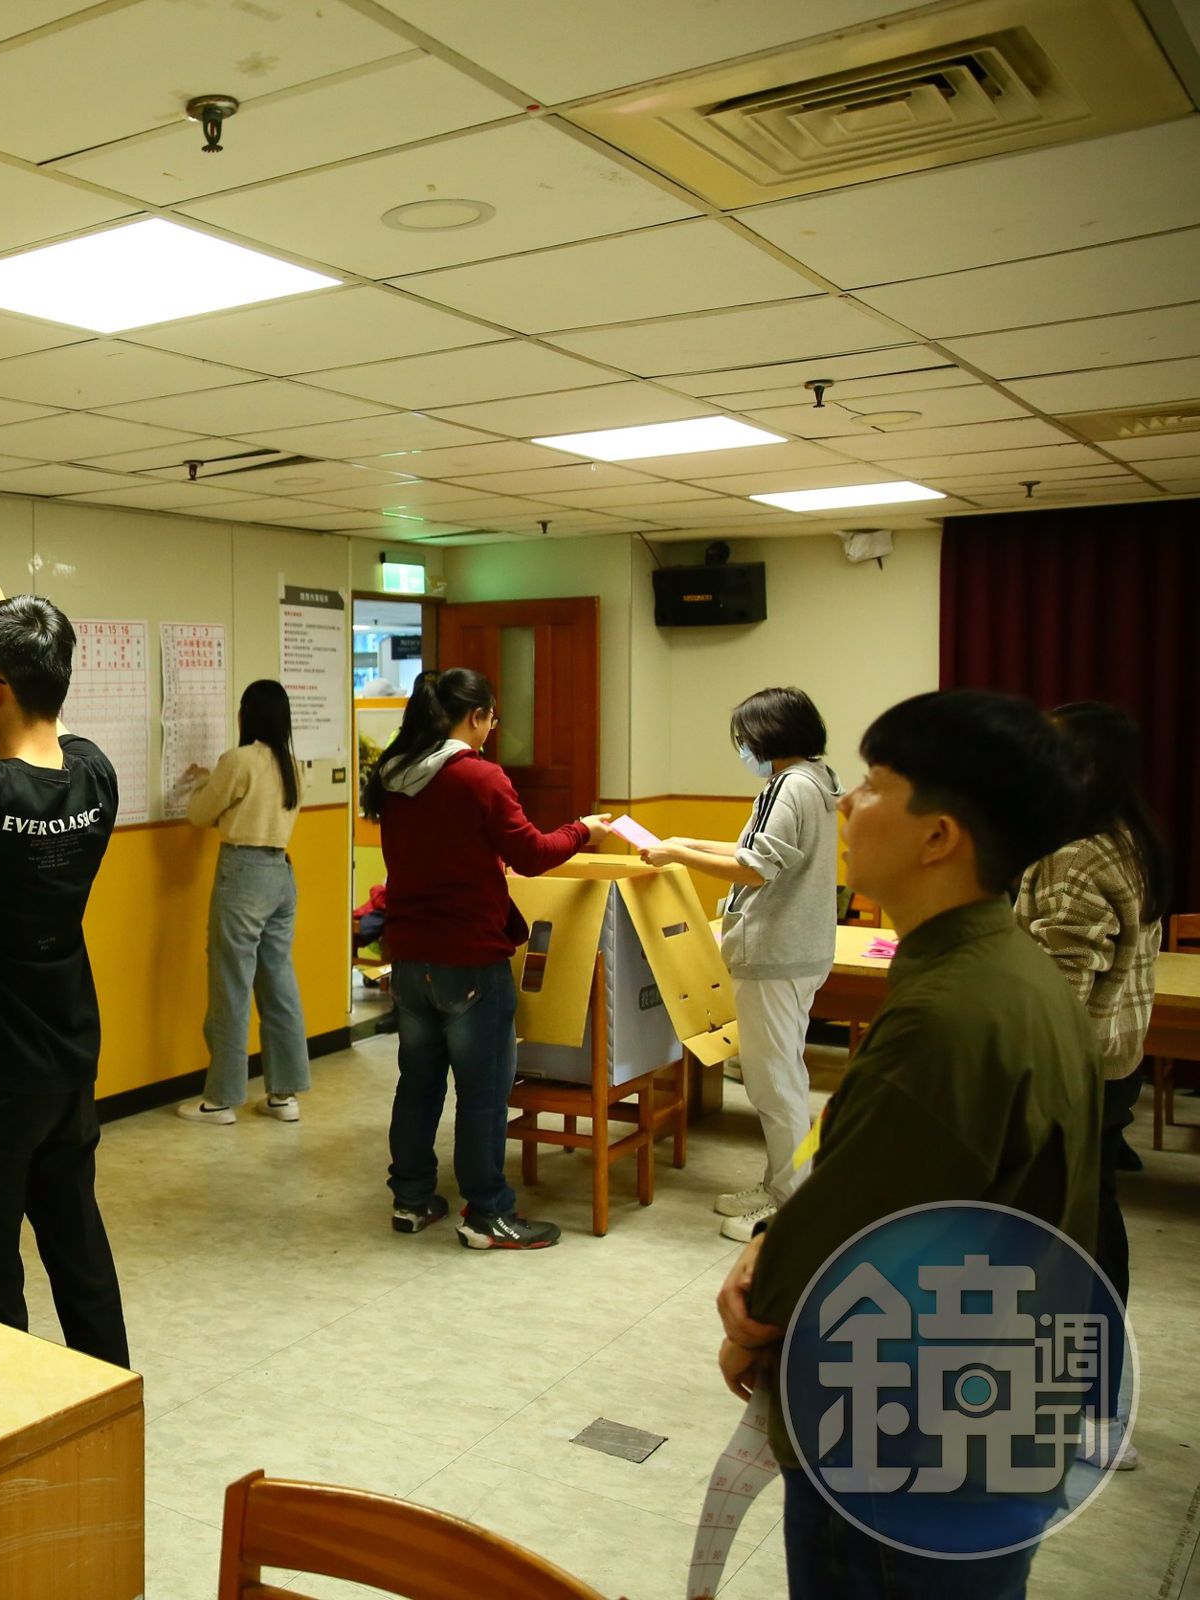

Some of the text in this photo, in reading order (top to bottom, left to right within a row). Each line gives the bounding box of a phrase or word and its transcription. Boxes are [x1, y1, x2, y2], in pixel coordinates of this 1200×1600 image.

[79, 624, 88, 634] 13
[95, 625, 103, 634] 14
[108, 625, 117, 634] 15
[121, 625, 129, 635] 16
[1, 807, 101, 836] EVER CLASSIC
[754, 1415, 766, 1427] 10
[716, 1476, 727, 1487] 20
[740, 1482, 753, 1493] 70
[725, 1514, 735, 1525] 75
